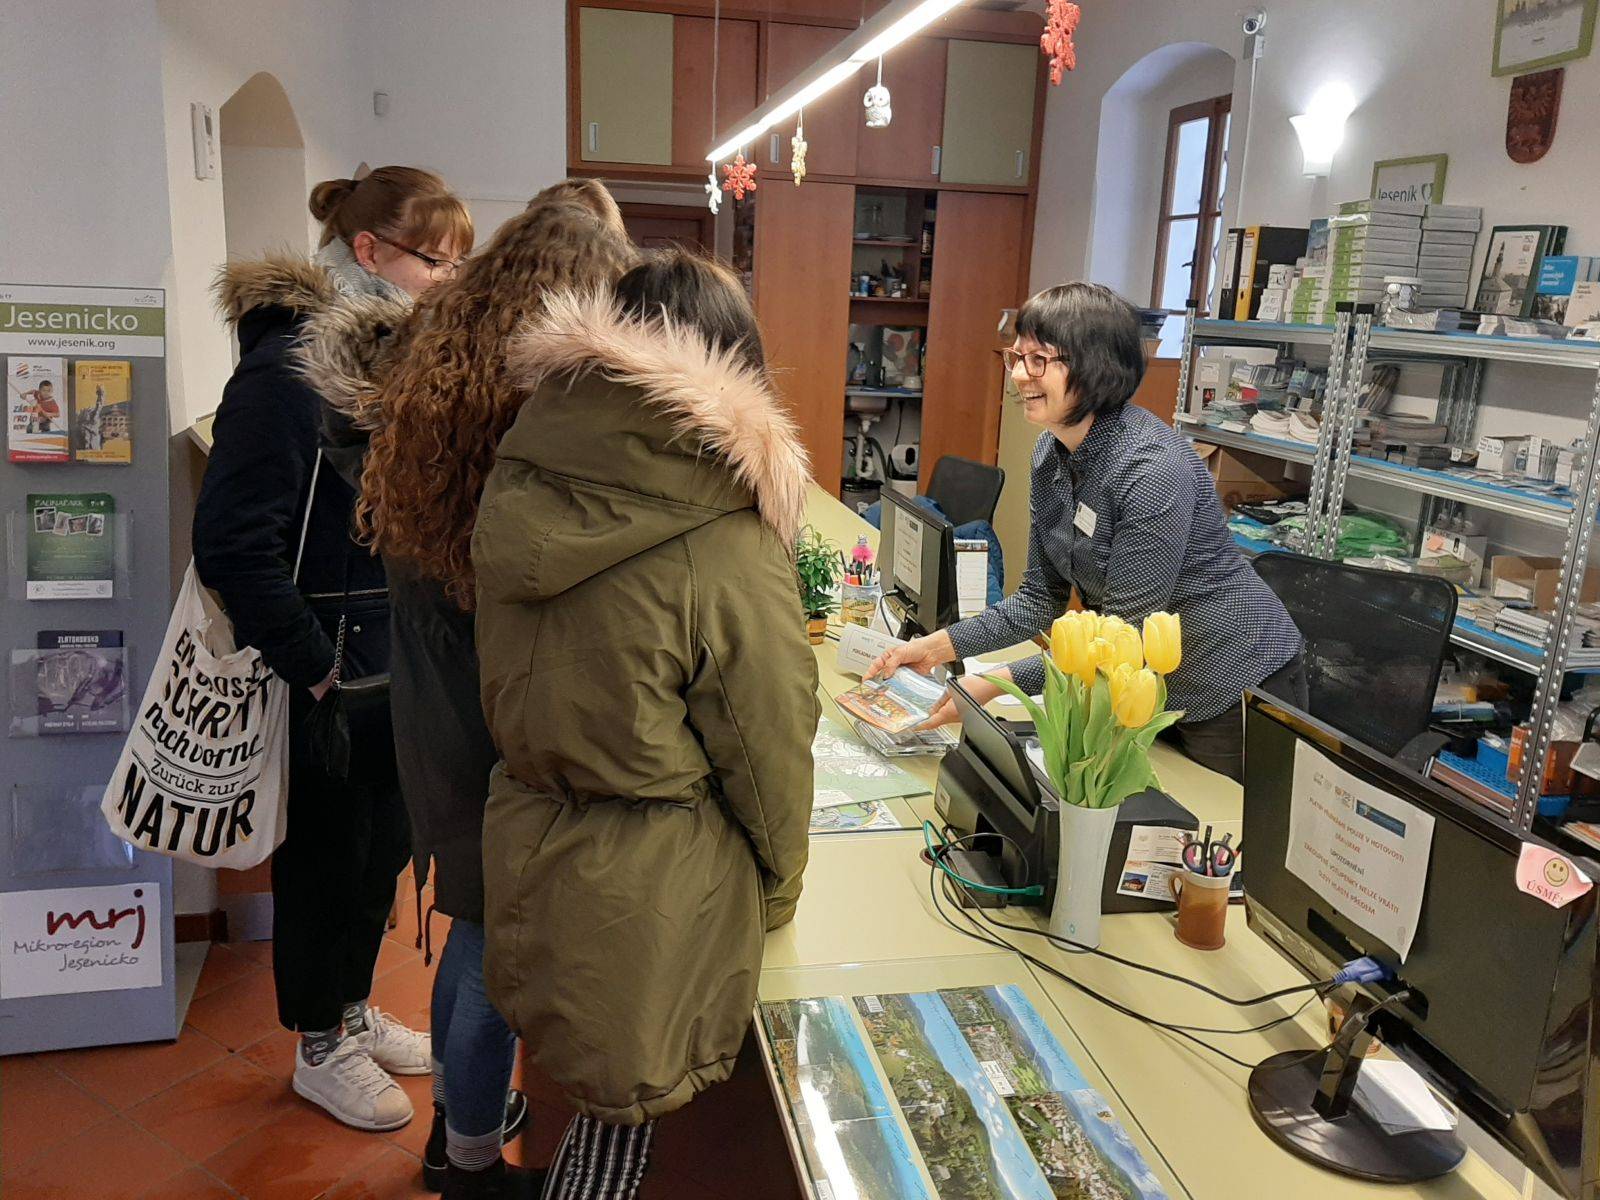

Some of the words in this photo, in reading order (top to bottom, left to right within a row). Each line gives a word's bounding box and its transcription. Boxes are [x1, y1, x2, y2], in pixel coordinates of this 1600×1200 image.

[4, 305, 139, 331] Jesenicko
[28, 338, 116, 350] www.jesenik.org
[150, 757, 206, 795] Zurück
[208, 780, 241, 796] zur
[117, 762, 256, 857] NATUR
[47, 888, 146, 950] mrj
[14, 936, 122, 954] Mikroregion
[58, 953, 140, 972] Jesenicko
